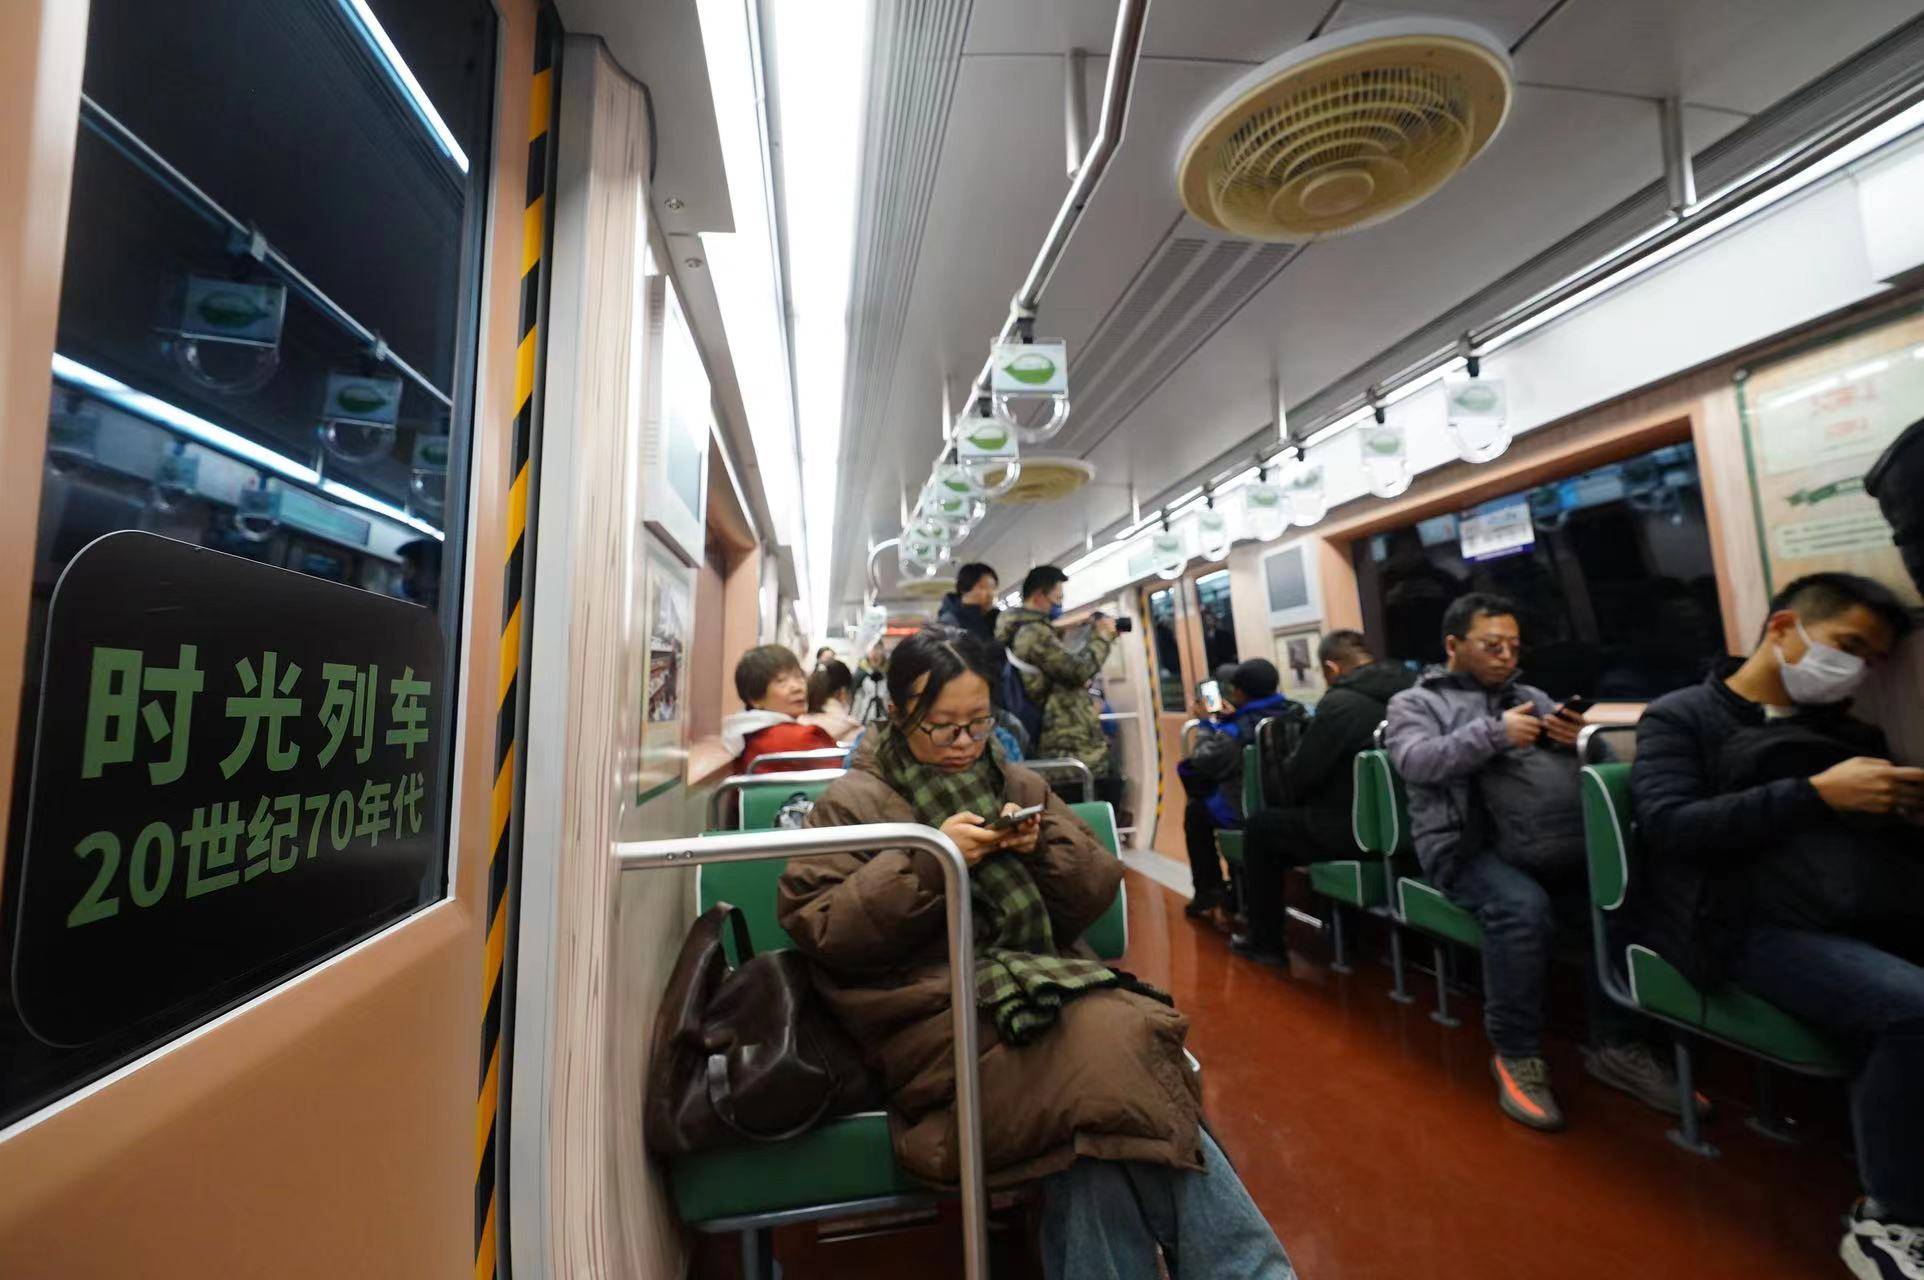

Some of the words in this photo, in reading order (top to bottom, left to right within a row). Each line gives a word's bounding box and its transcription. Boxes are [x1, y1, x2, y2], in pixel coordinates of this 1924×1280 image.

[82, 644, 431, 786] 时光列车
[67, 773, 424, 928] 20世纪70年代
